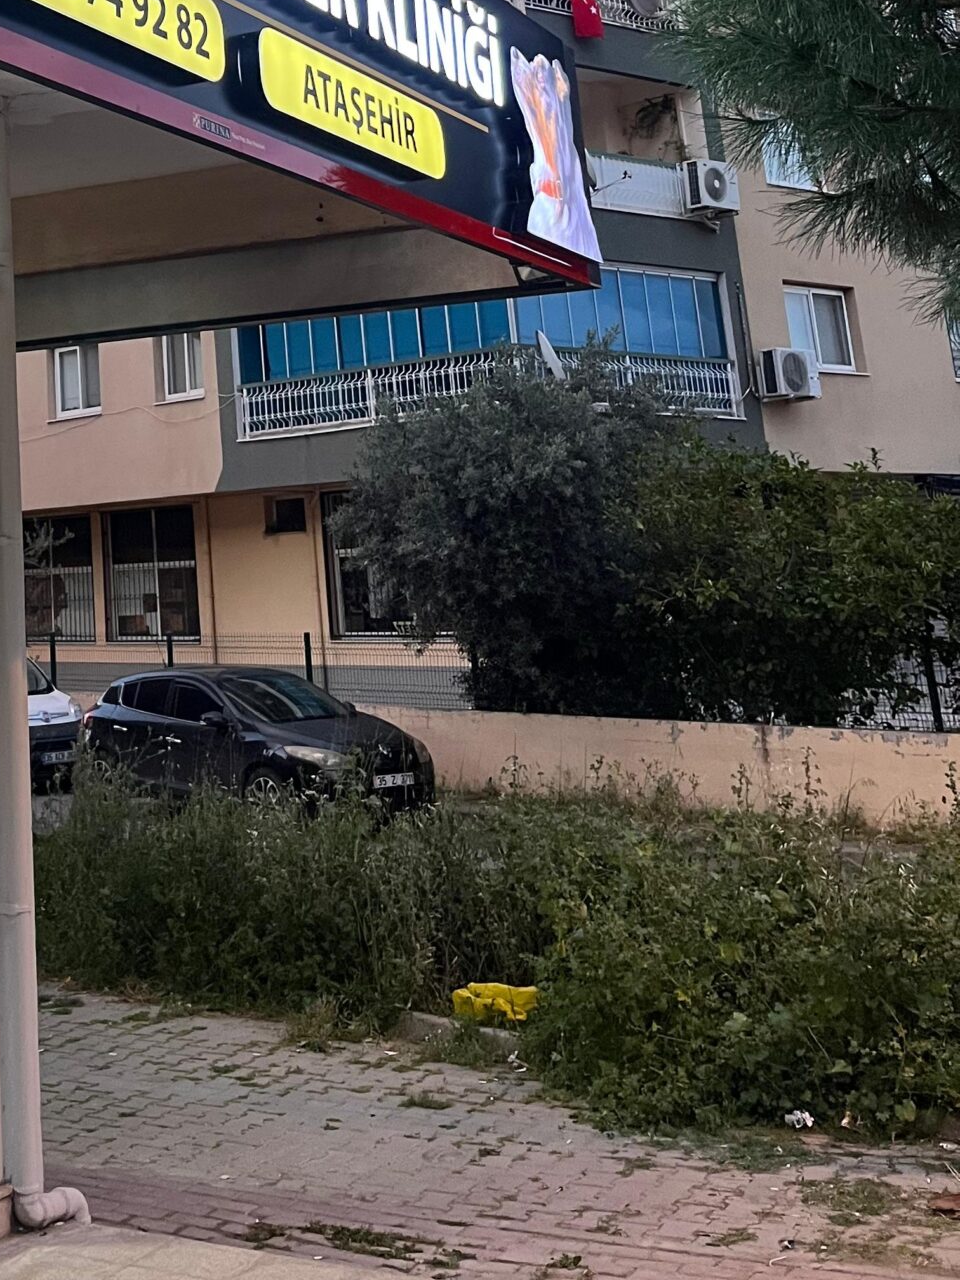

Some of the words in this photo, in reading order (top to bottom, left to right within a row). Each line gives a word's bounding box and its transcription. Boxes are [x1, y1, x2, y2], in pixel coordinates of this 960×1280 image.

[175, 3, 210, 60] 82
[200, 117, 230, 139] PURINA
[303, 63, 418, 154] ATAŞEHİR
